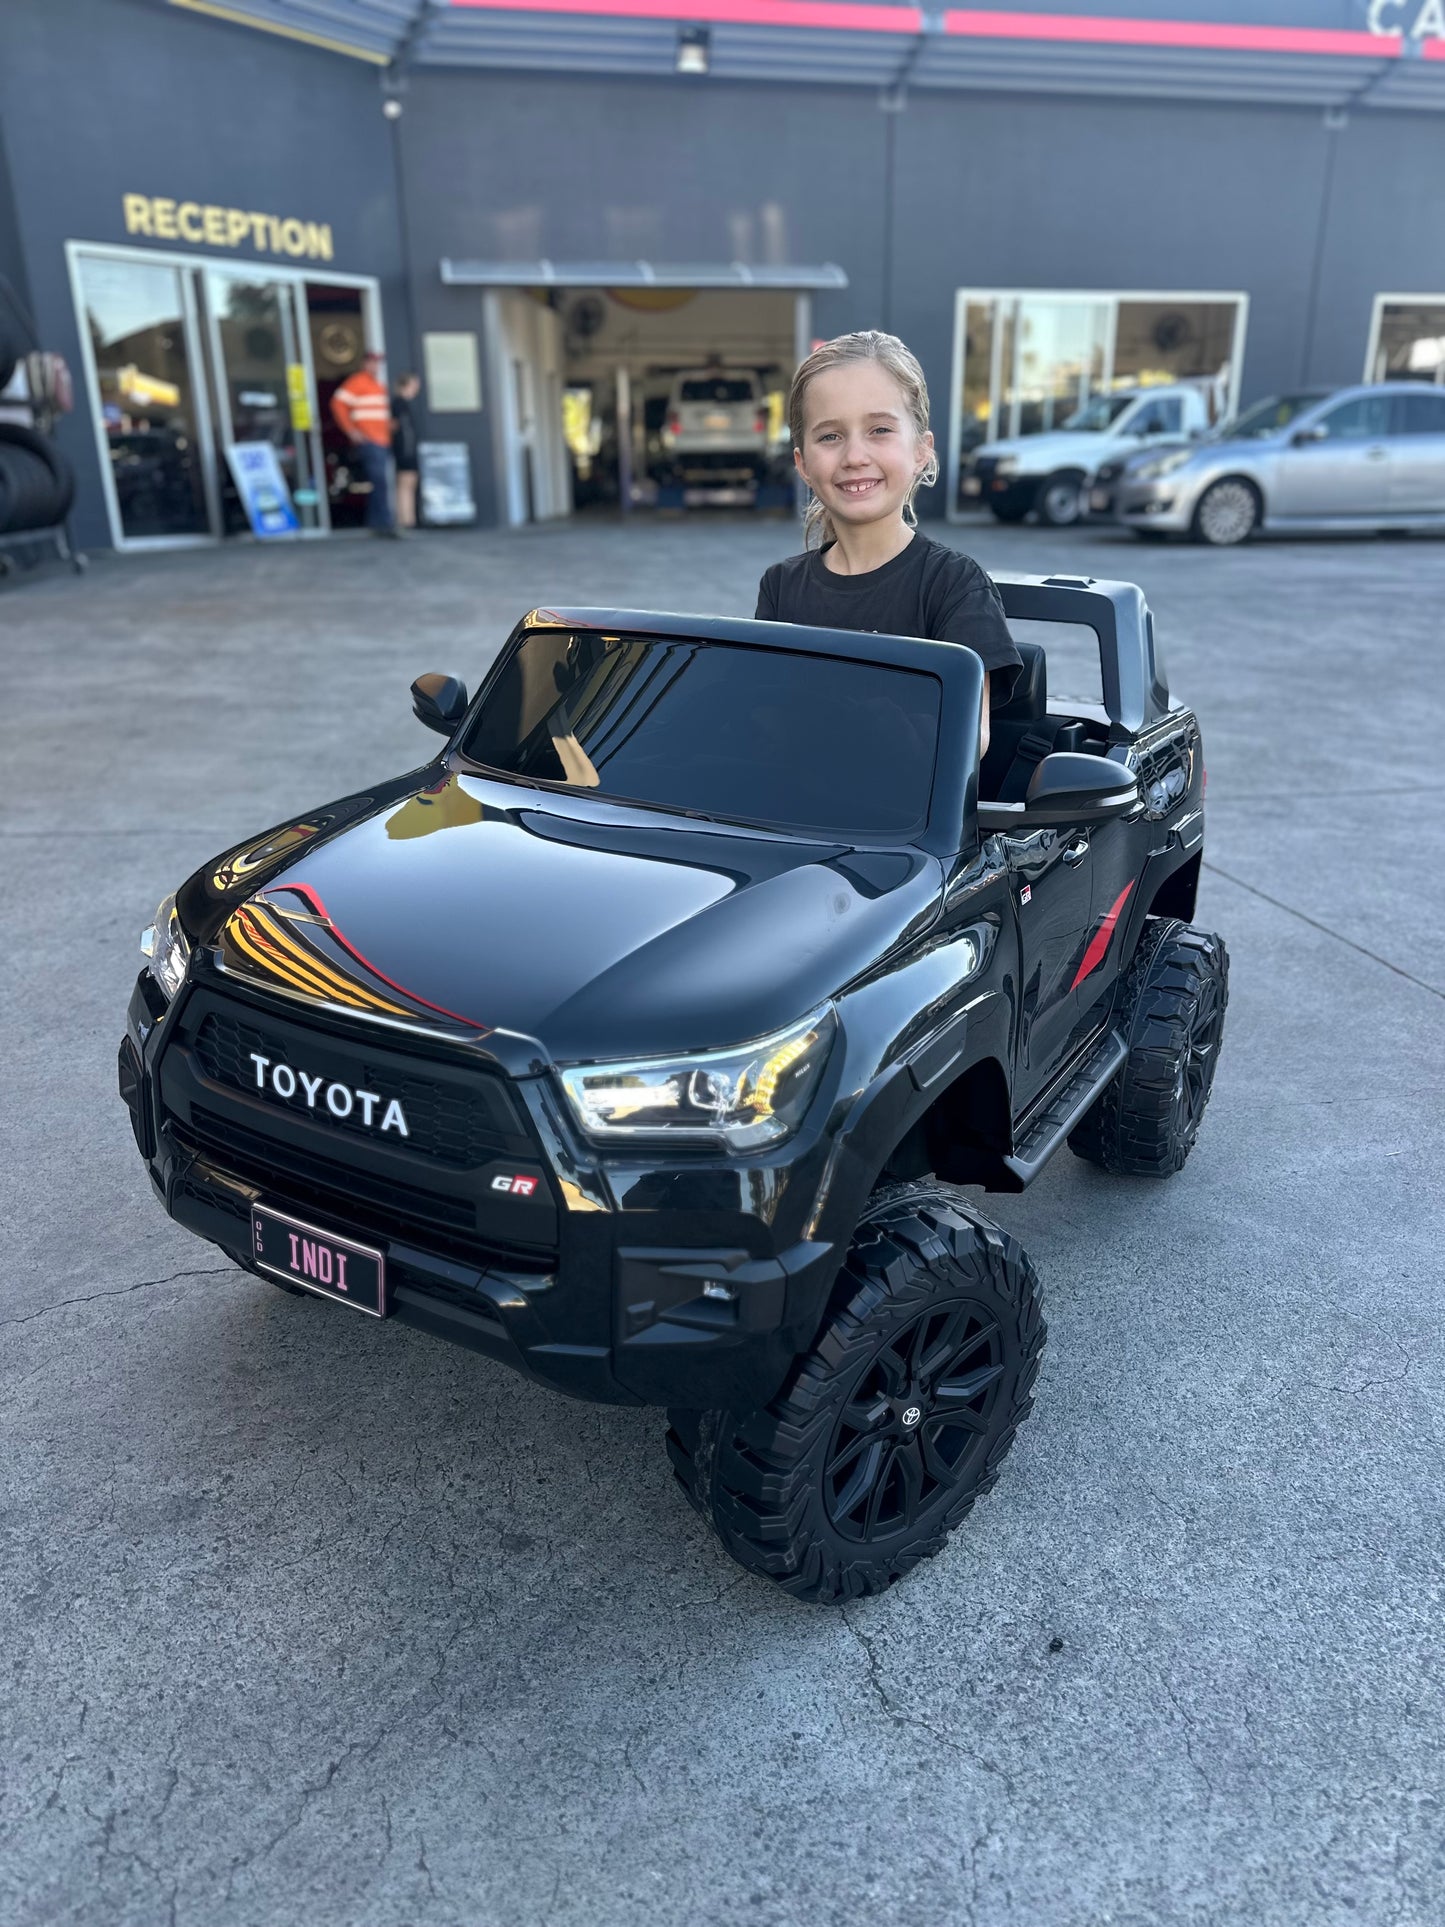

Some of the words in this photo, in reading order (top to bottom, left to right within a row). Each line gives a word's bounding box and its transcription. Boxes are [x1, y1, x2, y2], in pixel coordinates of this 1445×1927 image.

[123, 193, 334, 262] RECEPTION
[250, 1053, 409, 1136] TOYOTA
[491, 1176, 534, 1195] GR
[288, 1233, 348, 1291] INDI
